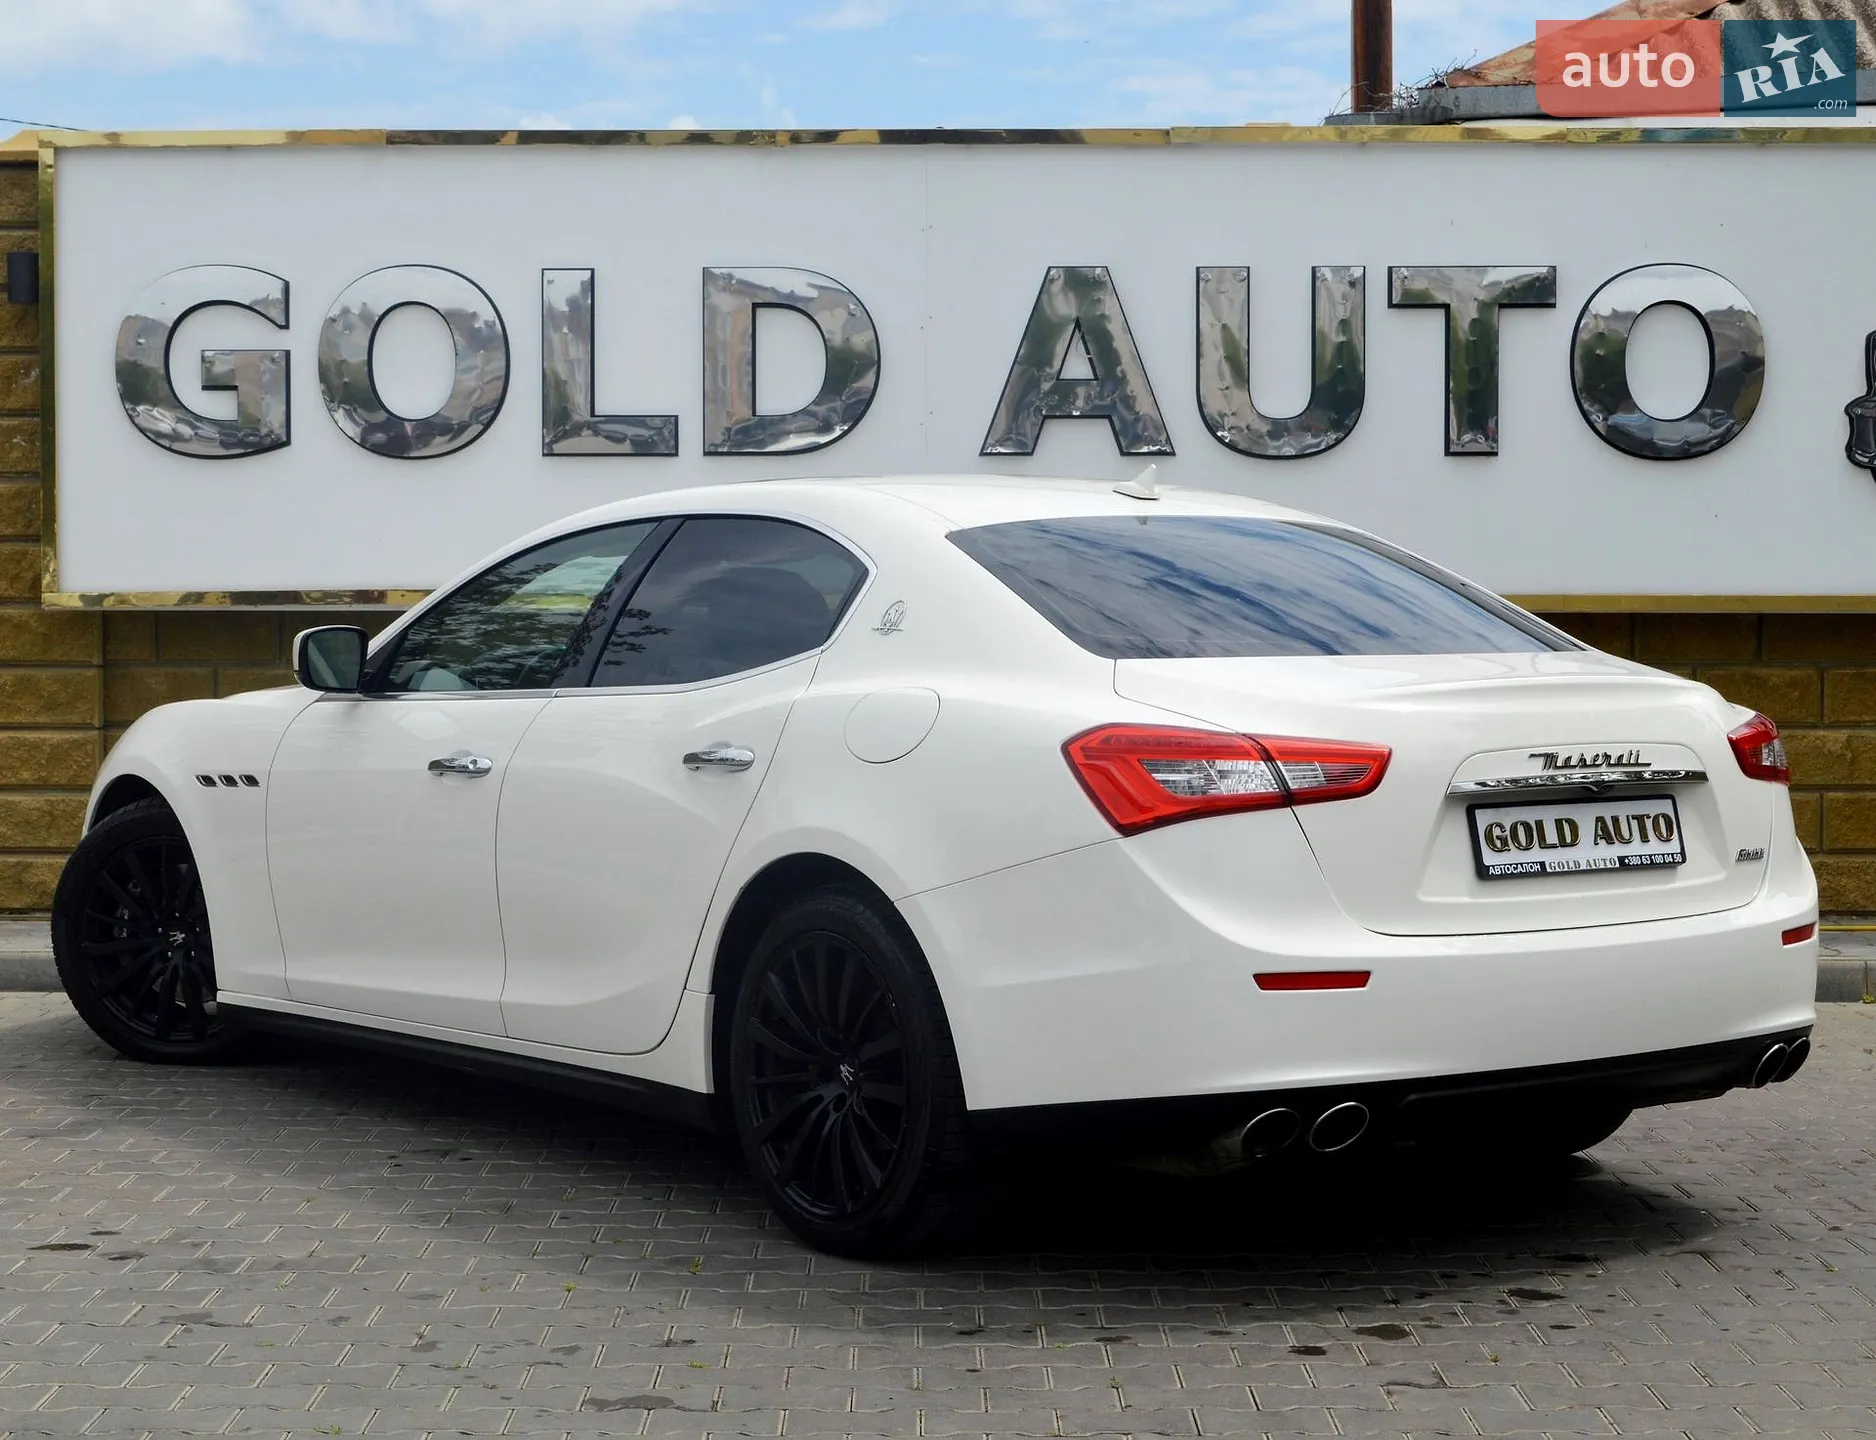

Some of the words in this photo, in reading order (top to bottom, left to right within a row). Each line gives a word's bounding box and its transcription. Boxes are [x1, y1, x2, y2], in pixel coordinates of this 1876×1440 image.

[114, 264, 881, 460] GOLD
[979, 263, 1766, 461] AUTO
[1528, 749, 1652, 771] Maserati
[1483, 817, 1581, 853] GOLD
[1593, 812, 1675, 846] AUTO
[1488, 863, 1541, 876] АВТОСАЛОН
[1549, 859, 1581, 872] GOLD
[1585, 857, 1617, 869] AUTO
[1624, 855, 1641, 866] +380
[1642, 855, 1651, 865] 63
[1652, 854, 1664, 864] 100
